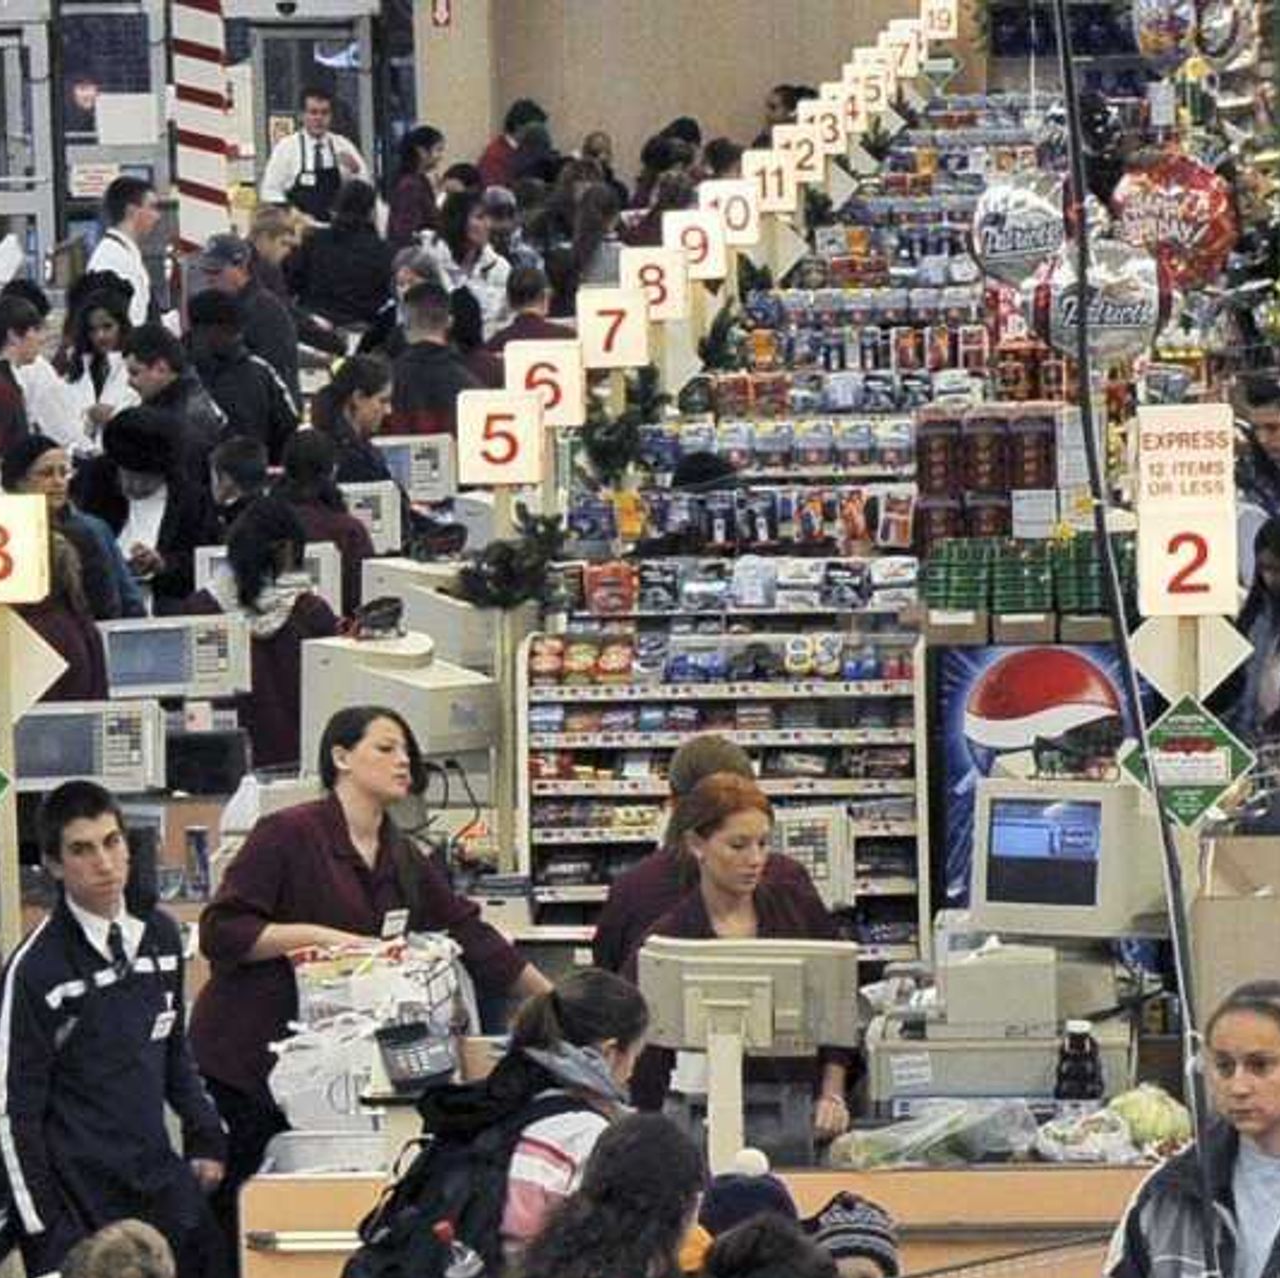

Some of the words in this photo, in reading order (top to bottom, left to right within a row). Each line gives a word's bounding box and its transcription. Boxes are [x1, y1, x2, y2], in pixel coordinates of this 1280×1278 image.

[680, 225, 708, 265] 9
[638, 263, 668, 307] 8
[595, 308, 627, 354] 7
[524, 361, 563, 410] 6
[480, 414, 519, 465] 5
[1141, 430, 1230, 451] EXPRESS
[1172, 461, 1225, 478] ITEMS
[1180, 479, 1225, 497] LESS
[1166, 531, 1211, 594] 2
